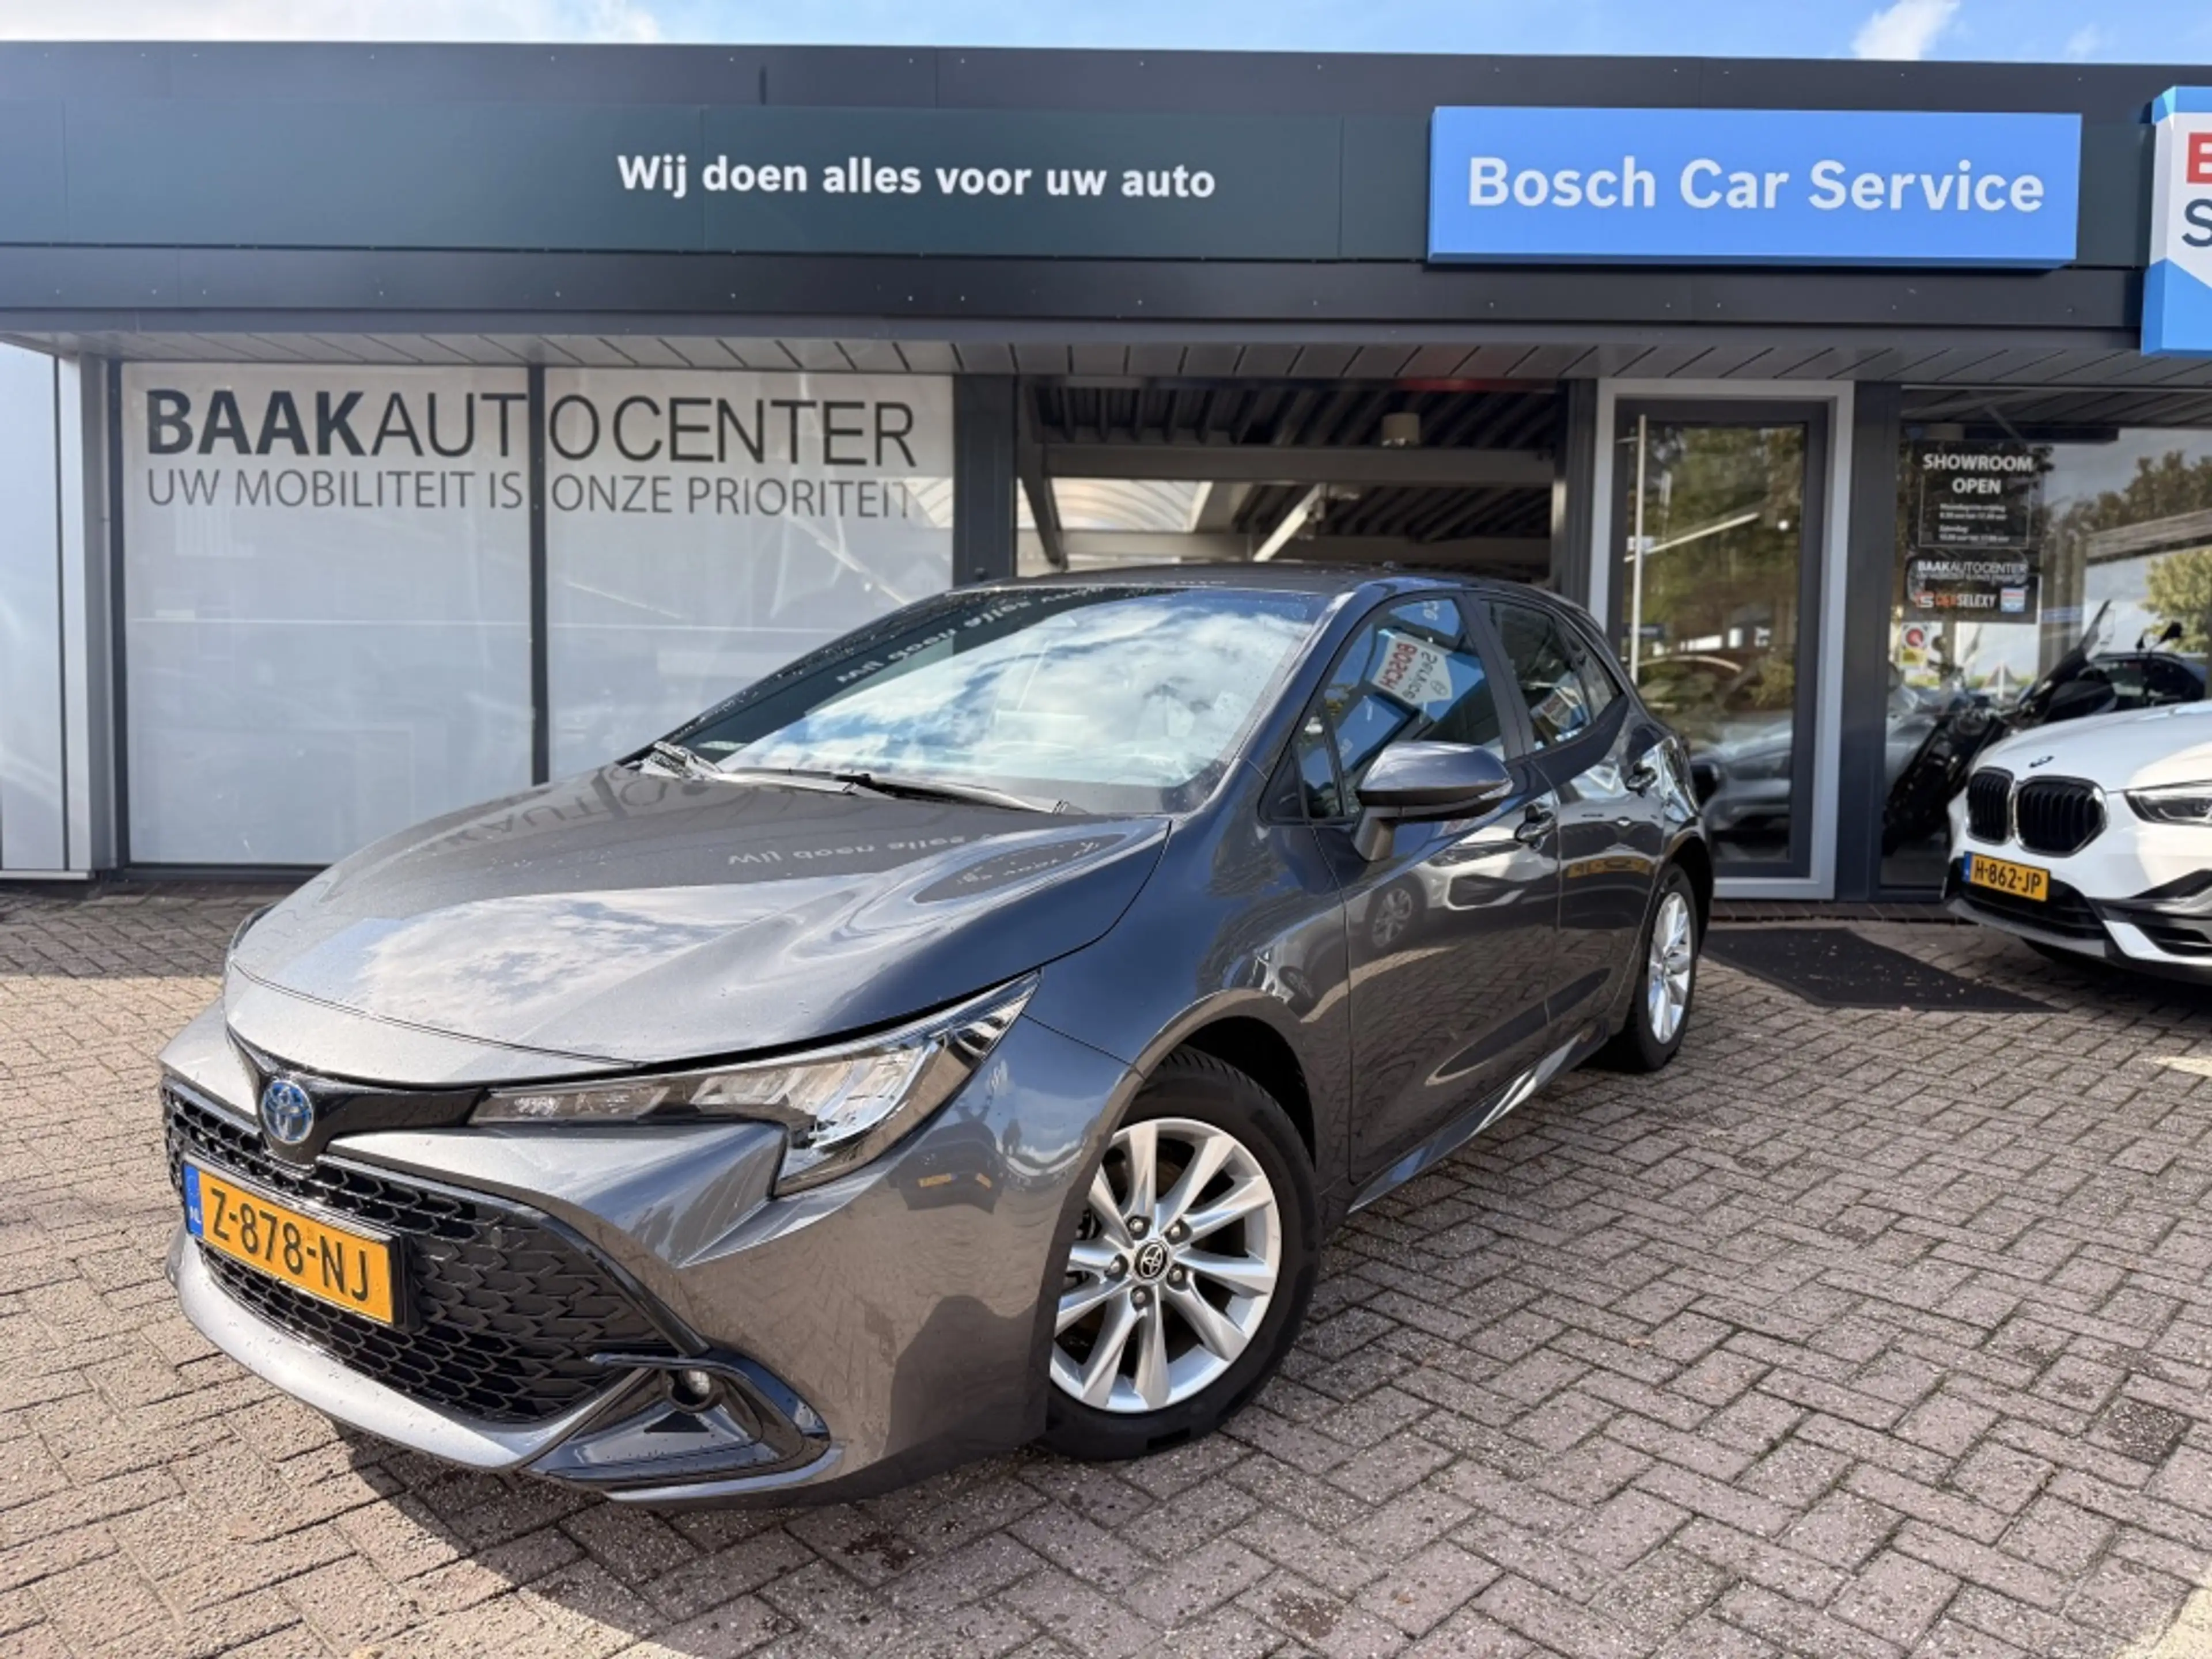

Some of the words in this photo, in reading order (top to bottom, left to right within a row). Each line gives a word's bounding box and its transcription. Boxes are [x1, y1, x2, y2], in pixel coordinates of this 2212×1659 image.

[618, 154, 687, 198] Wij
[703, 155, 806, 191] doen
[823, 157, 922, 194] alles
[935, 166, 1032, 195] voor
[1047, 168, 1107, 196] uw
[1122, 165, 1215, 198] auto
[1469, 156, 1655, 207] Bosch
[1680, 158, 1789, 209] Car
[1808, 160, 2044, 211] Service
[1923, 453, 2034, 472] SHOWROOM
[147, 468, 221, 506] UW
[236, 469, 476, 508] MOBILITEIT
[490, 471, 523, 509] IS
[551, 474, 673, 513] ONZE
[1952, 478, 2002, 494] OPEN
[1975, 859, 2041, 895] H-862-JP
[210, 1187, 369, 1302] Z-878-NJ
